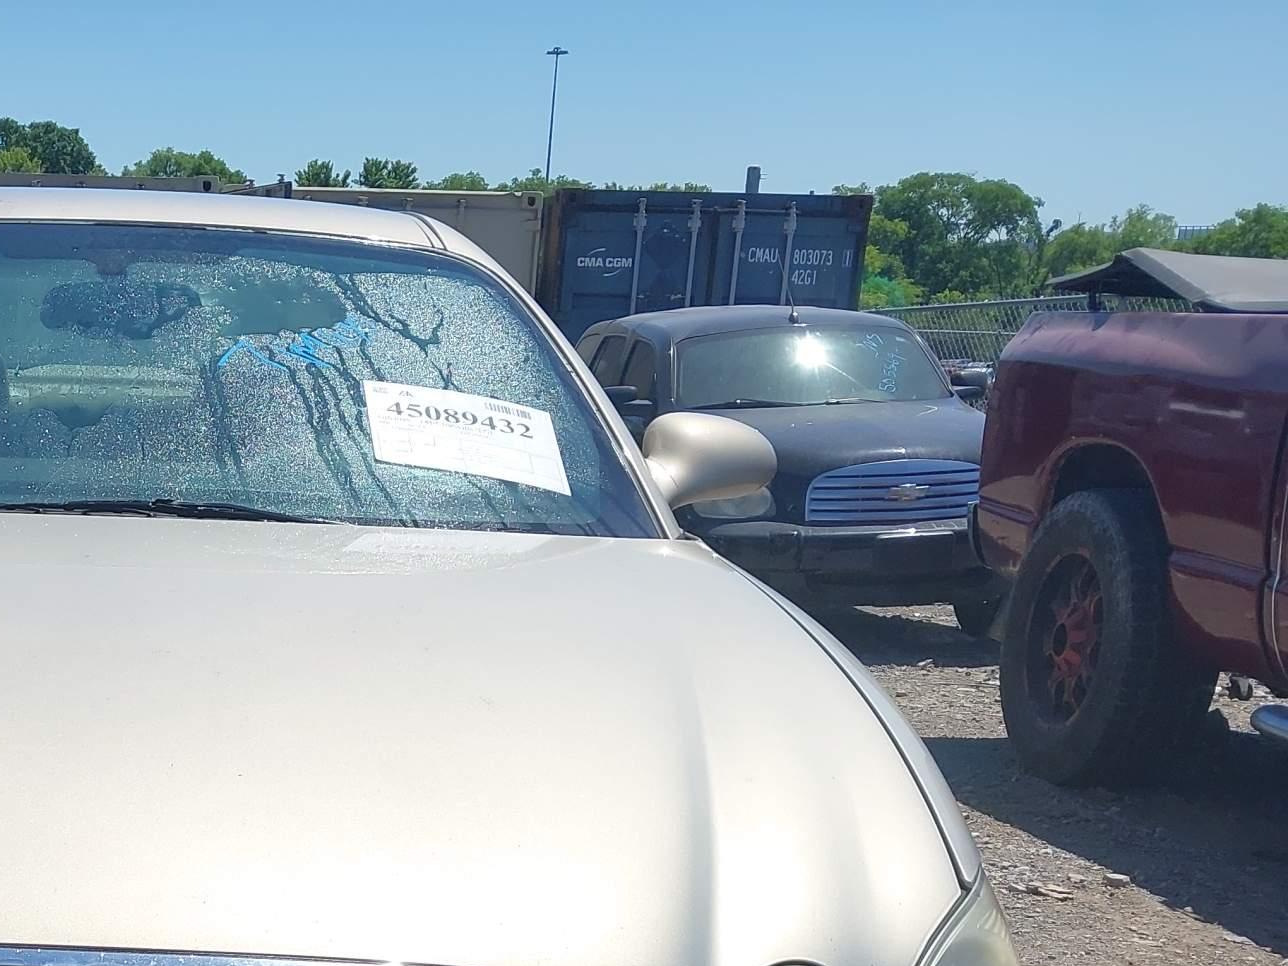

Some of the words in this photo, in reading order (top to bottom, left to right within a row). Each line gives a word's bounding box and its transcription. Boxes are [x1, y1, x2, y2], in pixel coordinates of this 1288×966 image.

[577, 257, 603, 268] CMA
[605, 257, 632, 268] CGM
[748, 247, 778, 263] CMAU
[793, 249, 833, 265] 803073
[792, 270, 817, 285] 42G1
[386, 401, 534, 439] 45089432
